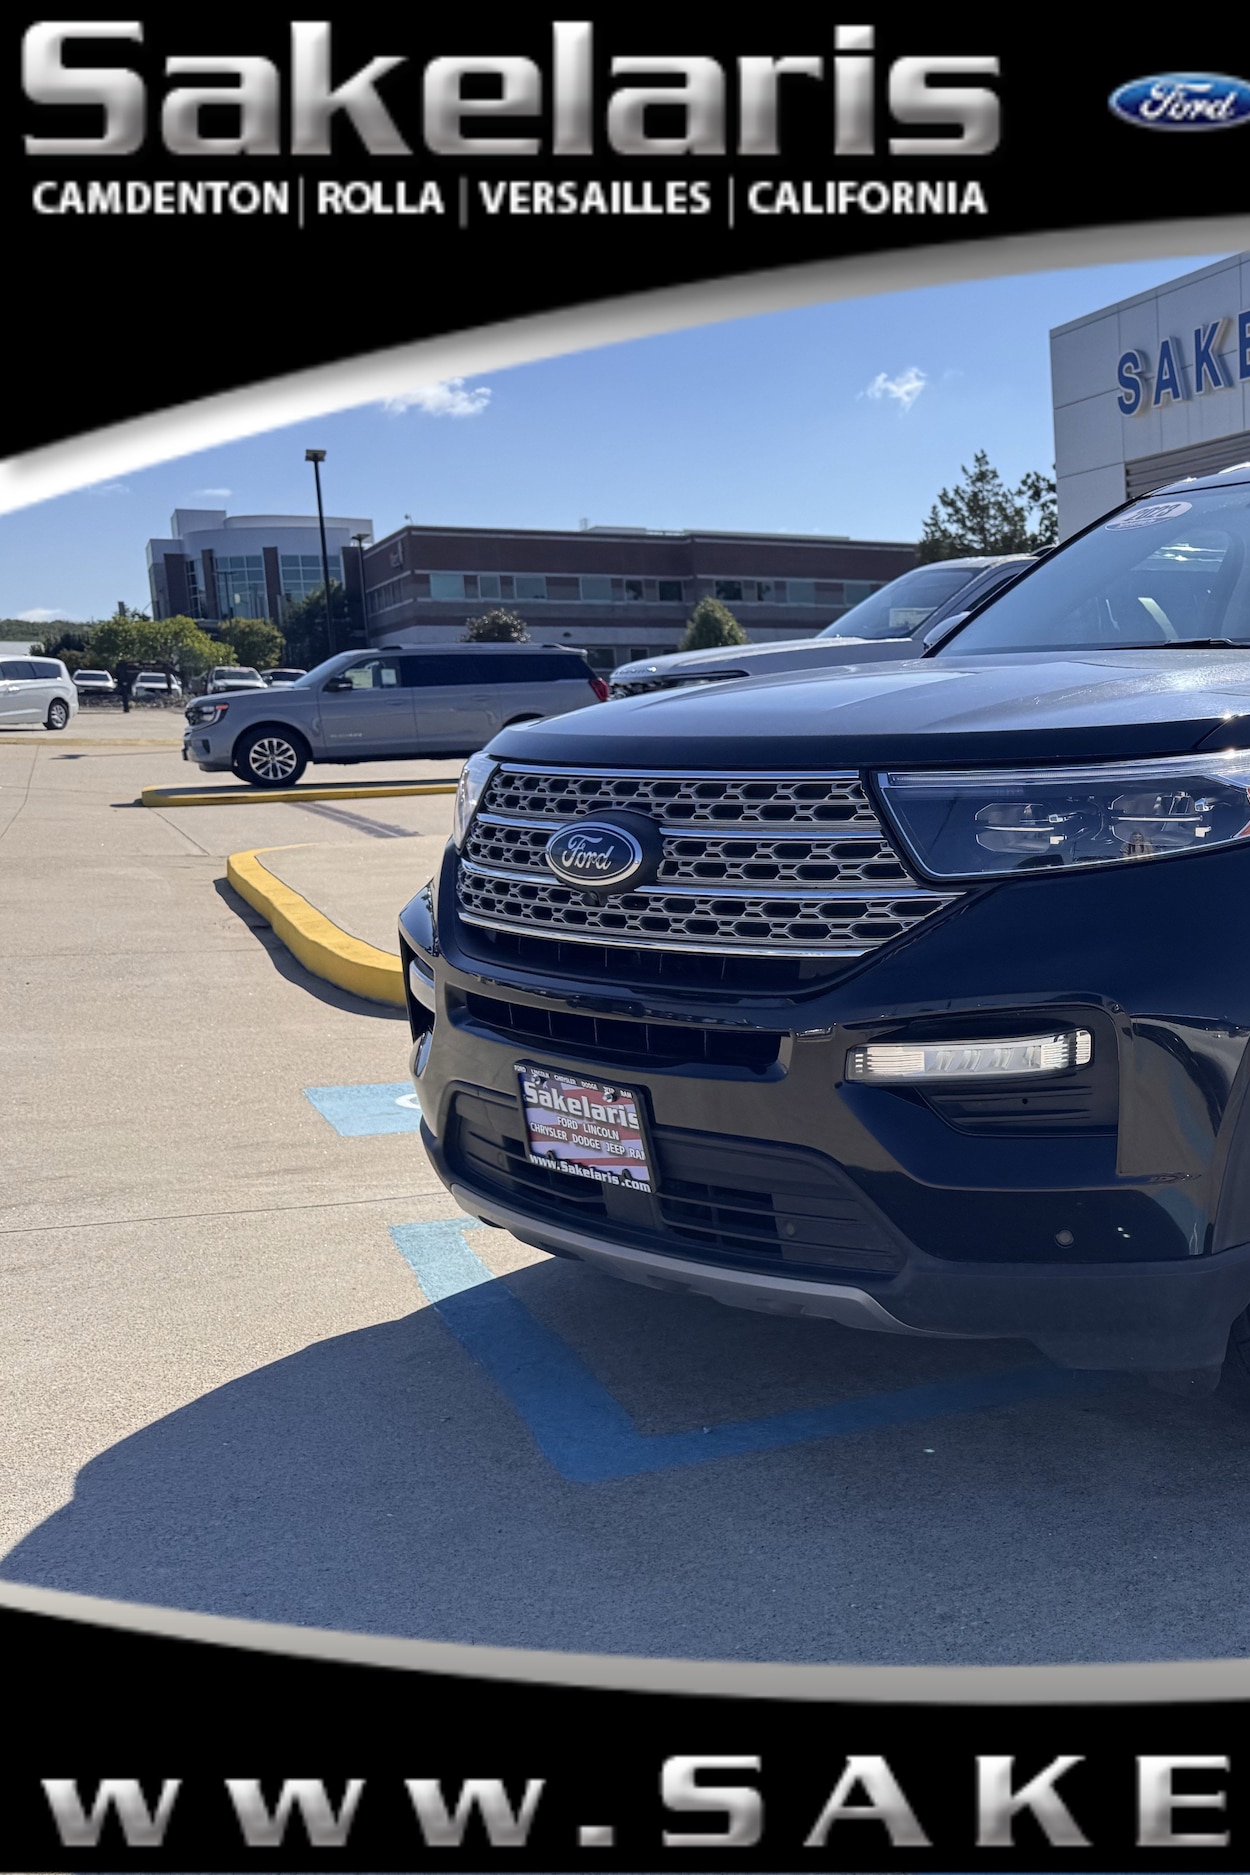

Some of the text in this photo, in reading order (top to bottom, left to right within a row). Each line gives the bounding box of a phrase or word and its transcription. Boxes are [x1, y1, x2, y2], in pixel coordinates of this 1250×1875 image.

[561, 833, 615, 871] Ford
[523, 1080, 640, 1130] Sakelaris
[530, 1122, 568, 1141] CHRYSLER
[572, 1133, 601, 1150] DODGE
[606, 1142, 626, 1156] JEEP
[556, 1116, 620, 1141] FORD LINCOLN
[529, 1153, 652, 1194] www.Sakelaris.com
